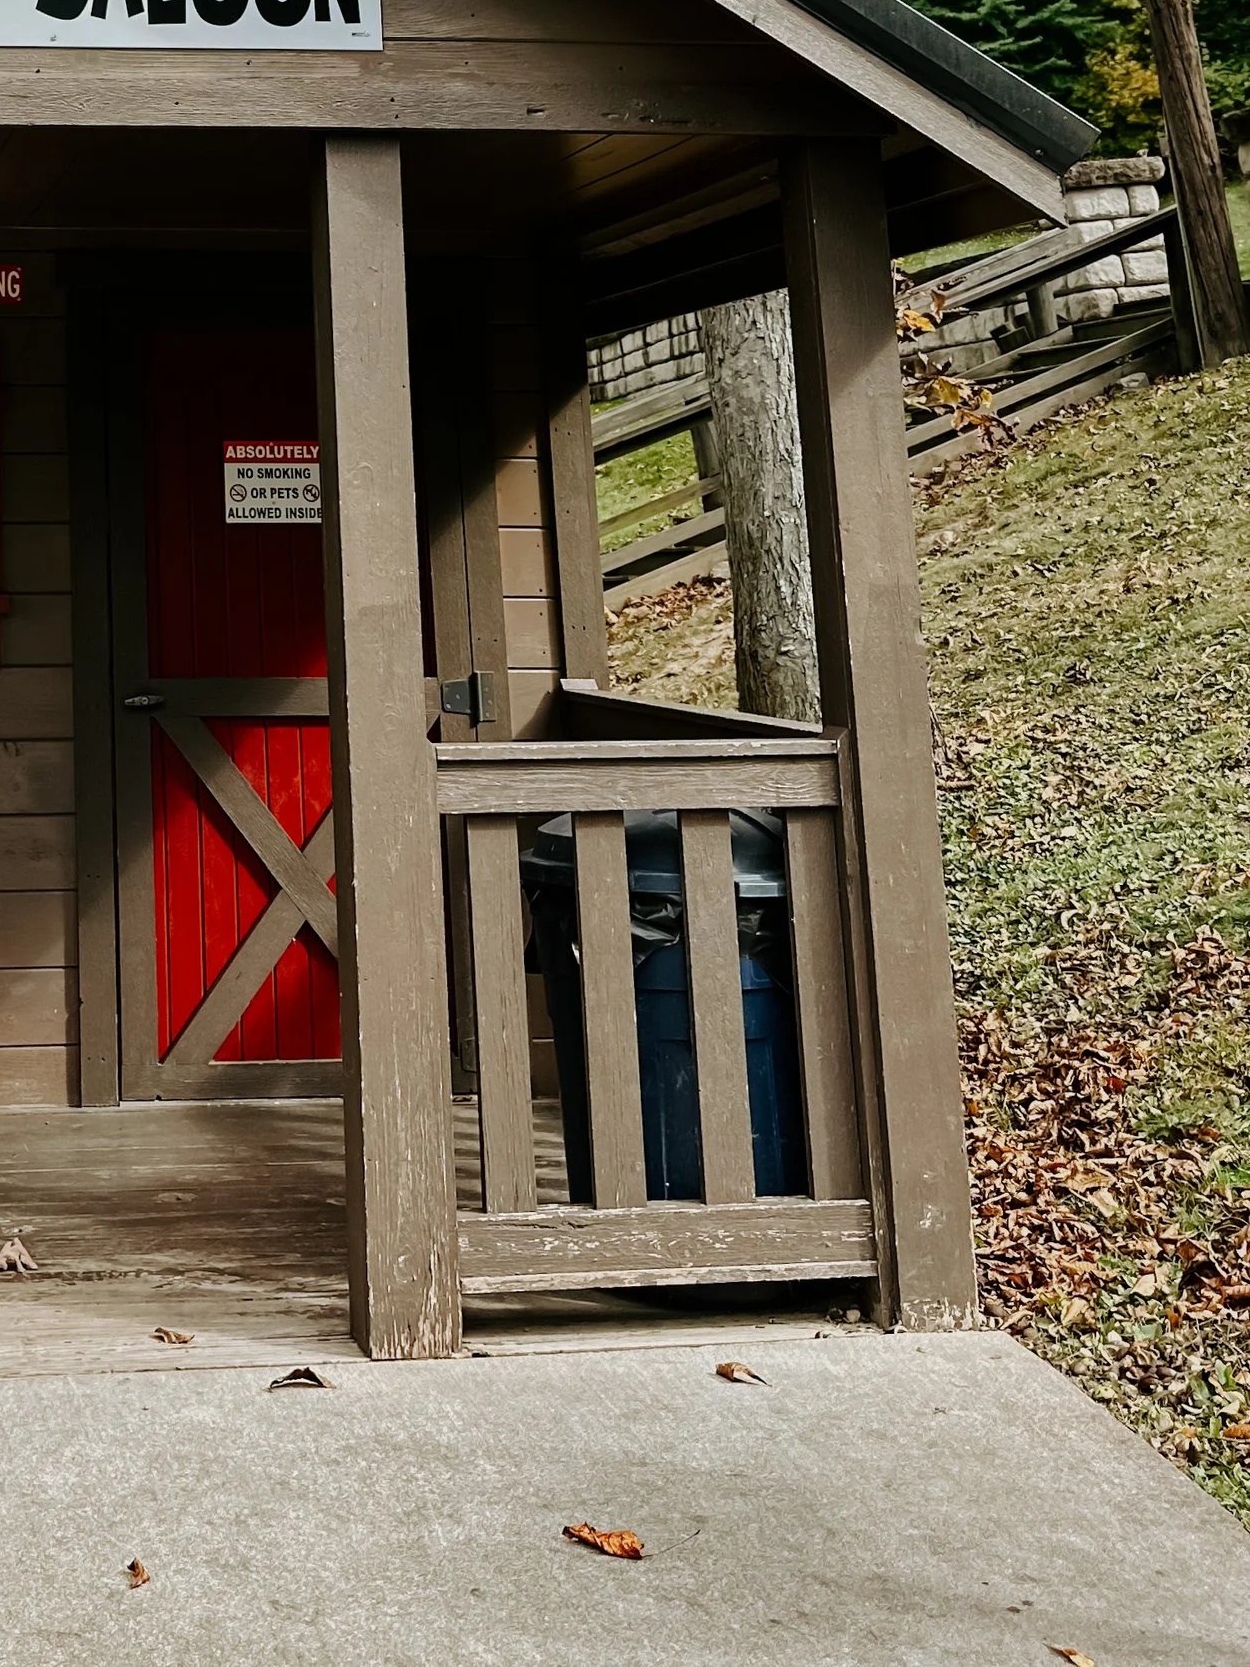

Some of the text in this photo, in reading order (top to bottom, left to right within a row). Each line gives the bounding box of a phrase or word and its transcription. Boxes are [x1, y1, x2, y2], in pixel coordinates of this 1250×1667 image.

[225, 445, 319, 459] ABSOLUTELY
[237, 467, 311, 479] NO SMOKING
[250, 487, 299, 499] OR PETS
[228, 507, 322, 519] ALLOWED INSIDE
